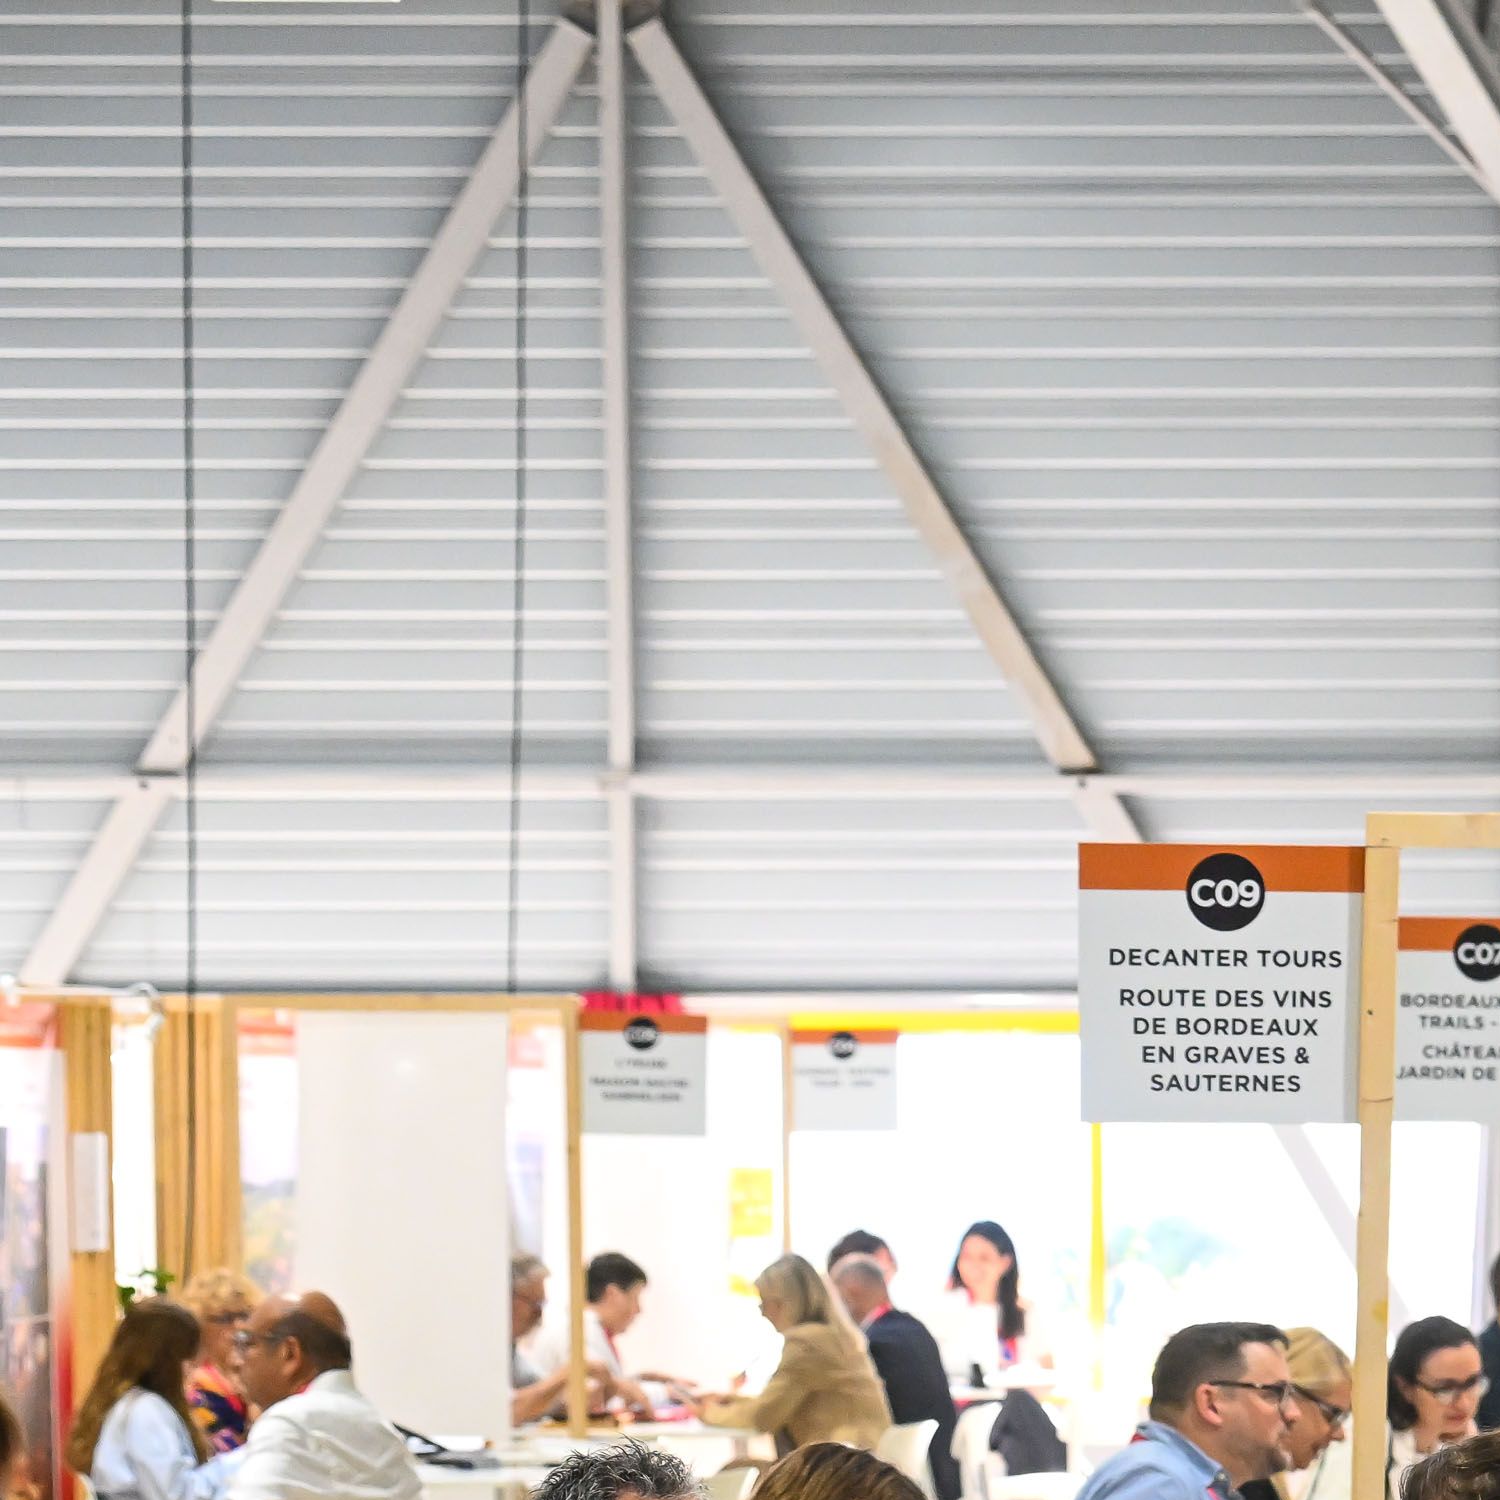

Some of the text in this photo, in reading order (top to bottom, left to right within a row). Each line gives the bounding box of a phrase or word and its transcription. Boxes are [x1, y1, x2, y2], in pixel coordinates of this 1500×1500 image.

[1190, 878, 1261, 909] C09
[1109, 948, 1342, 968] DECANTER TOURS
[1119, 988, 1332, 1008] ROUTE DES VINS
[1133, 1017, 1318, 1037] DE BORDEAUX
[1419, 1015, 1485, 1029] TRAILS
[1142, 1046, 1310, 1065] EN GRAVES &
[1397, 1066, 1466, 1080] JARDIN
[1472, 1067, 1496, 1080] DE
[1150, 1074, 1302, 1093] SAUTERNES
